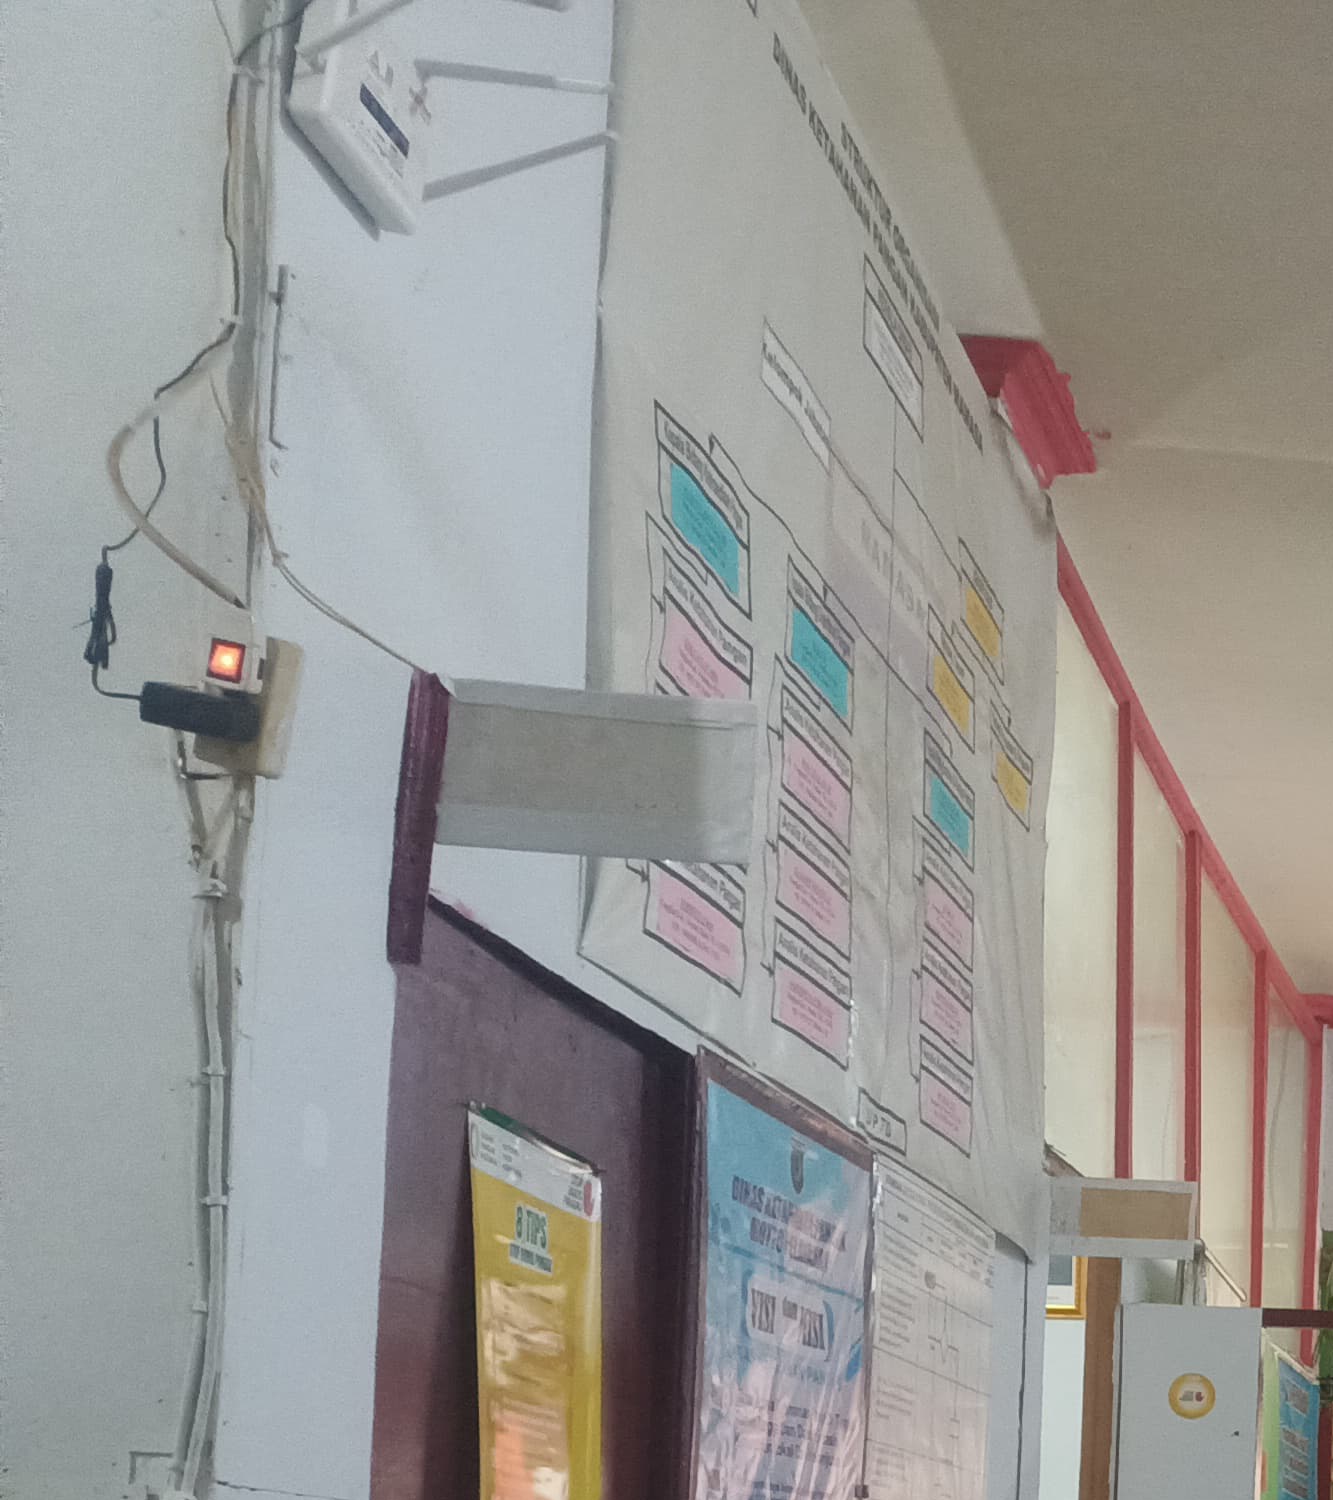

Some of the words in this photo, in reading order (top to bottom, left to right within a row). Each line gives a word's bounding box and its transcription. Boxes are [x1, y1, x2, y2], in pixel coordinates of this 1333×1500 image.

[773, 31, 807, 115] DINAS
[515, 1205, 524, 1239] 8
[526, 1209, 548, 1249] TIPS
